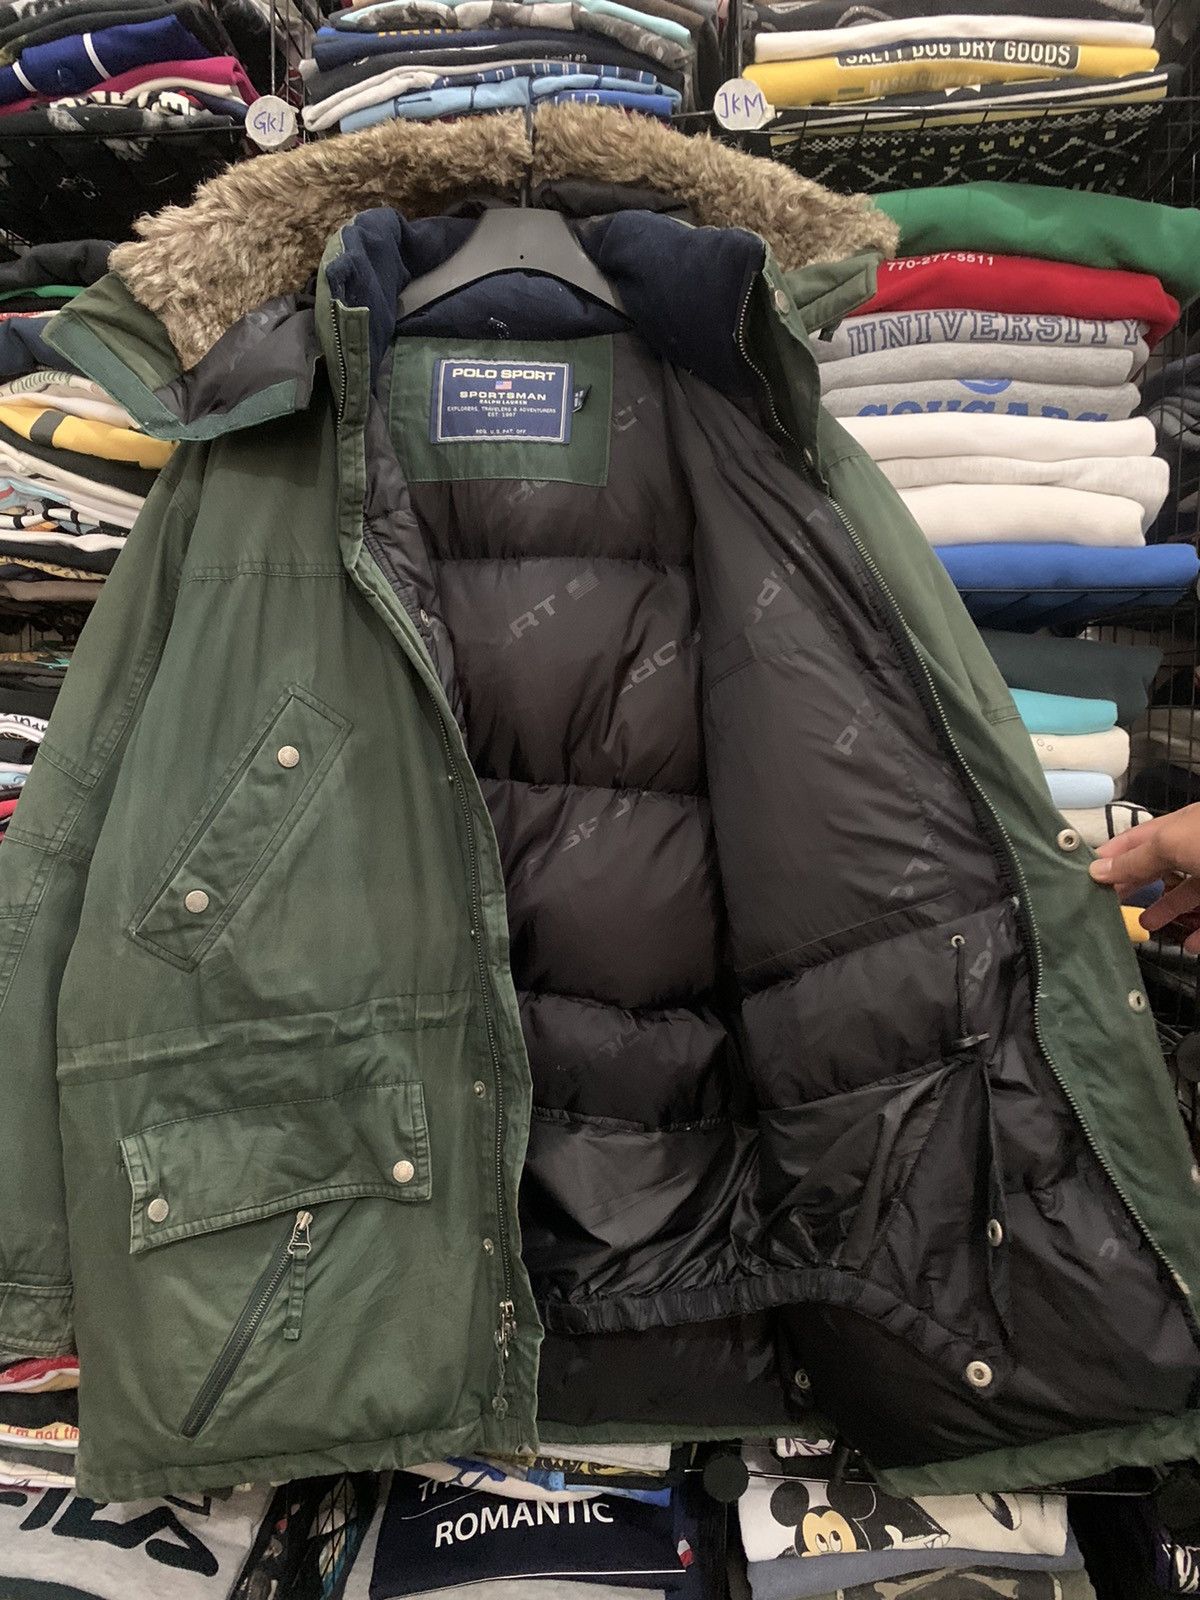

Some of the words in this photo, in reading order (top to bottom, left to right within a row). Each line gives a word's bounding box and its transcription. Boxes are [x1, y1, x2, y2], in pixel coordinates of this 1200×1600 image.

[1003, 40, 1071, 67] GOODS
[719, 92, 764, 118] JKM
[886, 252, 994, 272] 770-277-5511
[847, 311, 1141, 356] UNIVERSITY
[452, 367, 498, 379] POLO
[500, 369, 556, 382] SPORT
[459, 390, 547, 401] SPORTSMAN
[35, 1428, 59, 1440] not
[434, 1498, 615, 1549] ROMANTIC
